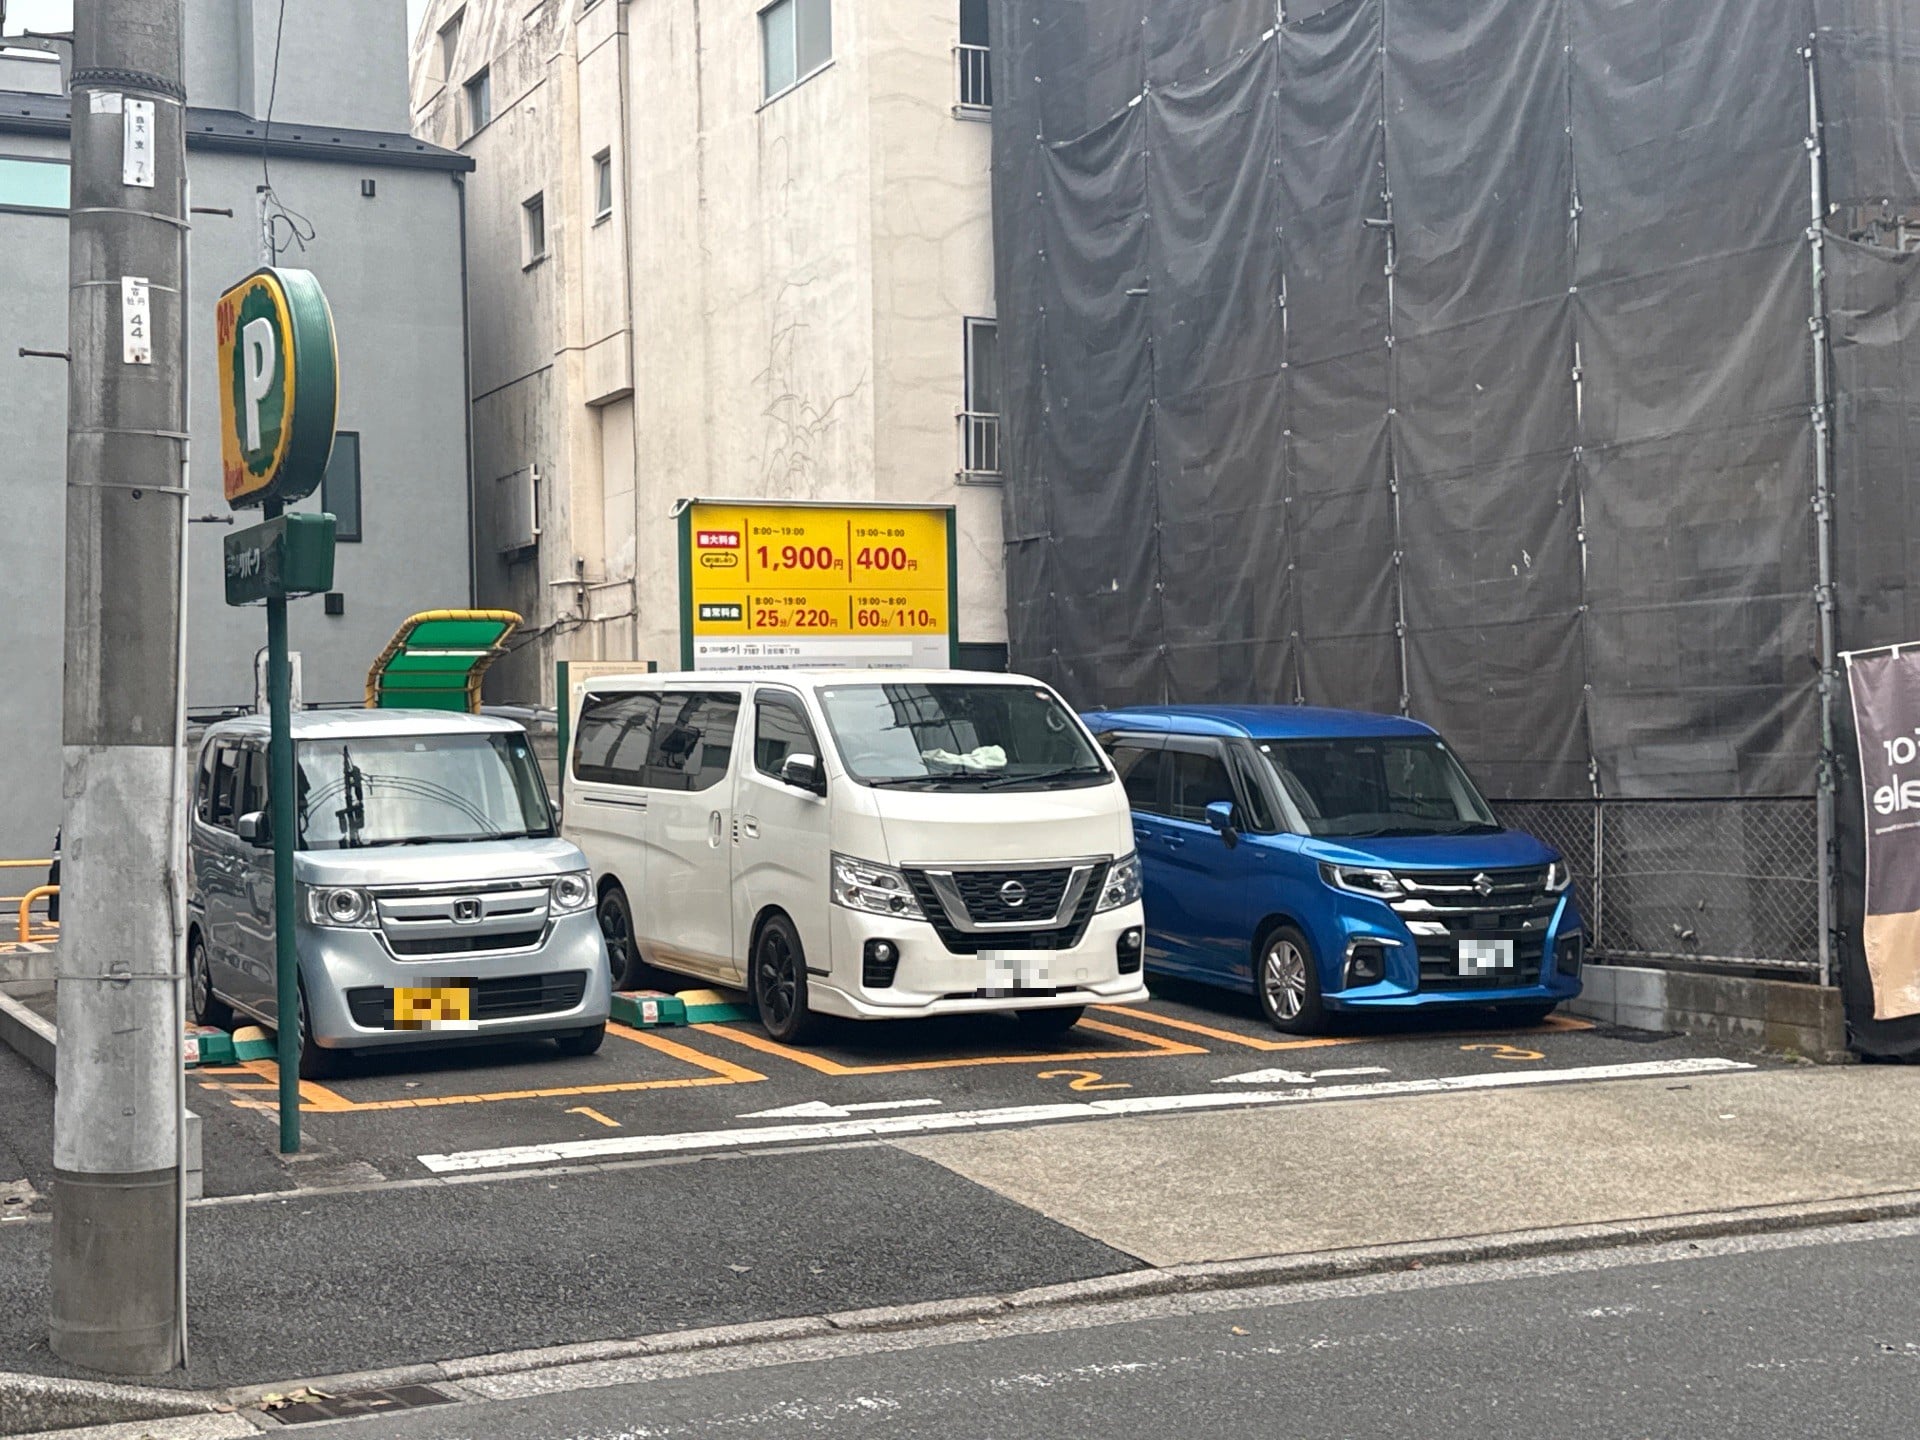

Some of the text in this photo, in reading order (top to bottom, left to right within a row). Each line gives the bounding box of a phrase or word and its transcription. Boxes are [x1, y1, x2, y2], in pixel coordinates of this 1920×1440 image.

[243, 317, 276, 451] P
[757, 545, 844, 571] 1,900円
[856, 547, 918, 571] 400円
[1459, 1043, 1546, 1061] 3
[1037, 1069, 1133, 1092] 2
[563, 1106, 622, 1128] 1
